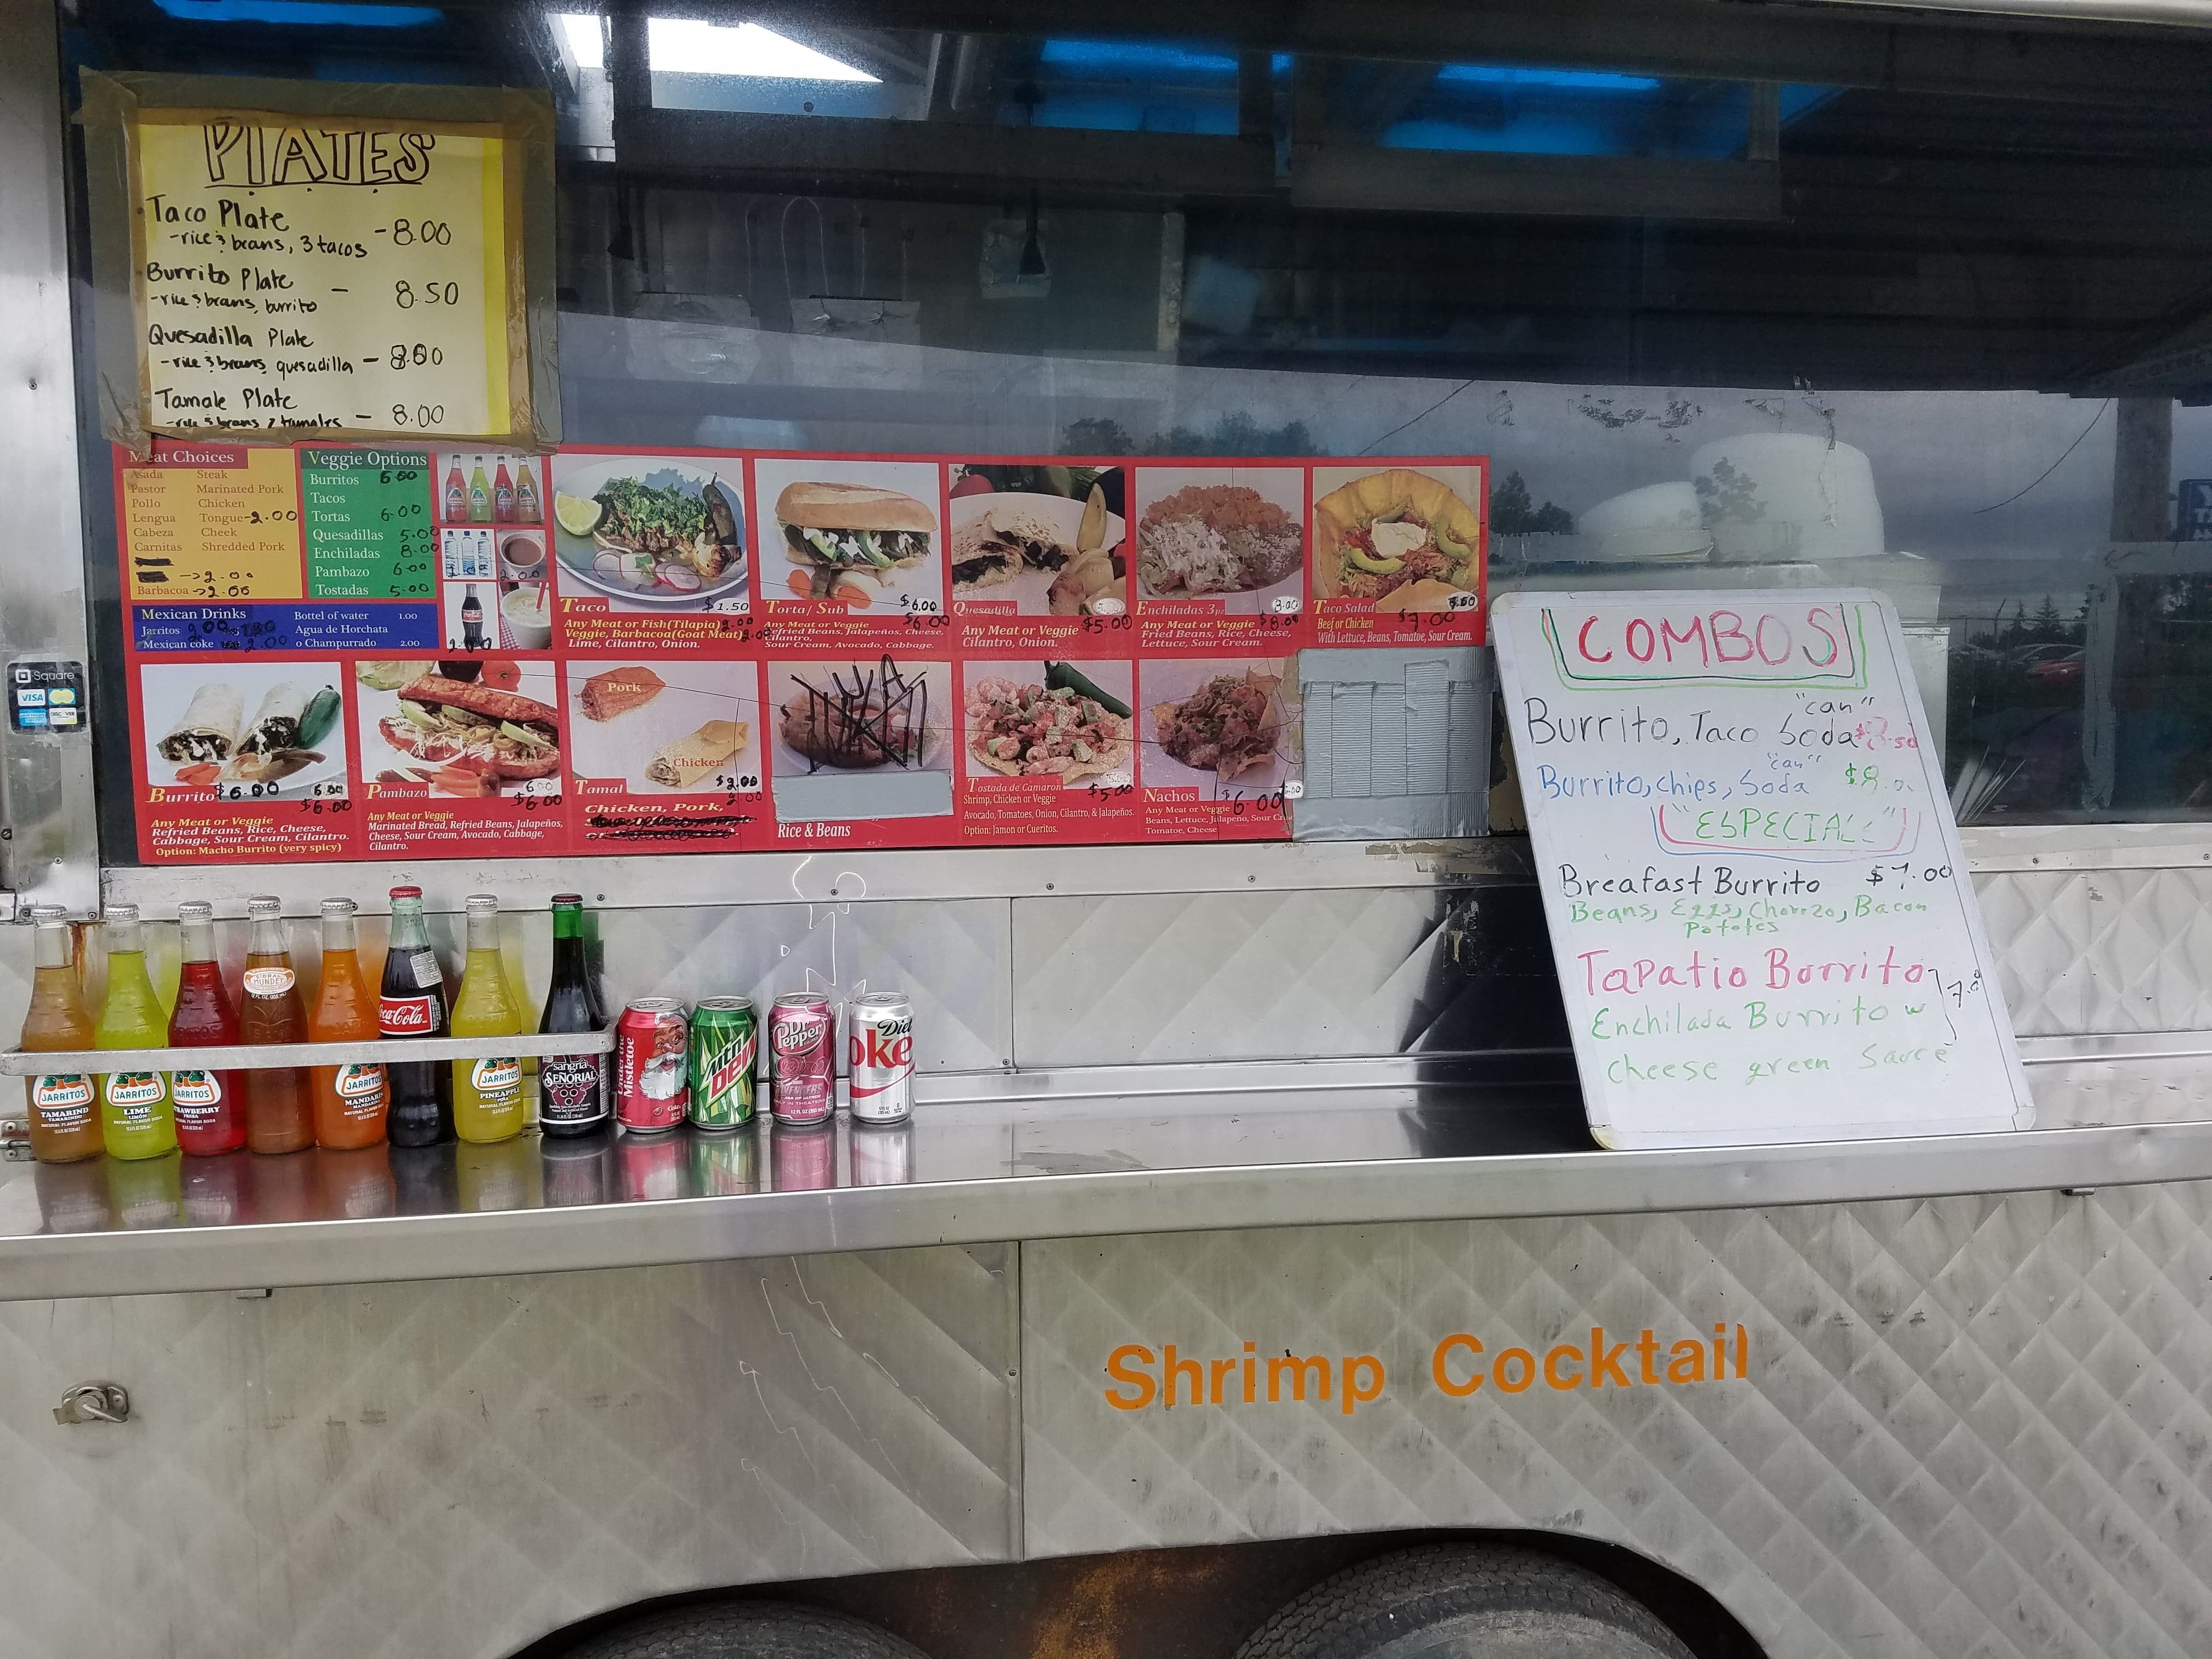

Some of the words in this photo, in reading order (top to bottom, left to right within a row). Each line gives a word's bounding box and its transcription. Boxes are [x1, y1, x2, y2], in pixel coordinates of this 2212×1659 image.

[145, 194, 206, 223] Taco
[218, 199, 290, 232] Plate
[300, 235, 313, 252] 3
[317, 234, 368, 258] tacos
[146, 261, 230, 285] Burrito
[241, 267, 294, 291] Plate
[395, 280, 460, 309] 8.50
[266, 298, 318, 313] burrito
[149, 324, 252, 347] Quesadilla
[269, 328, 314, 348] Plate
[276, 358, 354, 380] quesadilla
[154, 387, 227, 410] Tamale
[243, 388, 298, 409] Plate
[393, 404, 444, 427] 8.00
[173, 450, 234, 462] Choices
[309, 452, 363, 472] Veggie
[367, 452, 427, 473] Options
[197, 470, 228, 479] Steak
[310, 474, 359, 486] Burritos
[132, 485, 166, 493] Pastor
[196, 484, 253, 493] Marinated
[258, 485, 284, 493] Pork
[132, 499, 161, 507] Pollo
[199, 499, 245, 507] Chicken
[311, 493, 346, 503] Tacos
[133, 514, 176, 526] Lengua
[200, 513, 243, 526] Tongue
[312, 511, 350, 522] Tortas
[133, 527, 174, 537] Cabeza
[201, 527, 237, 537] Cheek
[313, 529, 383, 541] Quesadillas
[134, 542, 182, 551] Carnitas
[202, 541, 256, 551] Shredded
[259, 542, 285, 551] Pork
[314, 548, 380, 558] Enchiladas
[315, 566, 370, 577] Pambazo
[137, 586, 189, 595] Barbacoa
[316, 584, 369, 595] Tostadas
[560, 598, 606, 613] Taco
[816, 602, 844, 614] Sub
[953, 601, 1015, 617] Quesadilla
[1136, 601, 1203, 616] Enchiladas
[1313, 600, 1342, 614] Taco
[1345, 602, 1375, 612] Salad
[142, 609, 197, 619] Mexican
[202, 608, 246, 619] Drinks
[295, 611, 324, 620] Bottel
[328, 611, 338, 620] of
[341, 612, 369, 620] water
[296, 625, 323, 636] Agua
[326, 624, 338, 634] de
[341, 624, 388, 634] Horchata
[565, 619, 588, 629] Any
[642, 619, 720, 630] Fish(Tilapia)
[142, 627, 180, 636] Jarritos
[566, 629, 608, 640] Veggie,
[612, 630, 706, 639] Barbacoa(Goat
[708, 630, 743, 639] Meat)
[1578, 608, 1838, 667] COMBOS
[190, 640, 213, 648] coke
[305, 638, 376, 650] Champurrado
[34, 671, 75, 682] Square
[608, 682, 642, 692] Pork
[1525, 697, 1681, 747] Burrito,
[1690, 710, 1758, 744] Taco
[1780, 713, 1859, 748] Soda
[674, 758, 724, 767] Chicken
[575, 780, 623, 795] Tamal
[968, 778, 1007, 793] Tostada
[147, 788, 215, 803] Burrito
[366, 785, 427, 800] Pambazo
[1143, 789, 1195, 803] Nachos
[963, 795, 991, 806] Shrimp,
[994, 794, 1021, 804] Chicken
[1032, 793, 1056, 805] Veggie
[585, 805, 667, 813] Chicken,
[674, 803, 723, 812] Pork,
[964, 810, 996, 820] Avocado,
[997, 810, 1034, 819] Tomatoes,
[1035, 809, 1058, 818] Onion,
[1060, 808, 1090, 818] Cilantro,
[1092, 808, 1097, 816] &
[1099, 807, 1134, 817] Jalapeños.
[152, 827, 200, 837] Refried
[202, 826, 243, 836] Beans,
[247, 826, 276, 835] Rice,
[280, 825, 326, 834] Cheese,
[778, 823, 802, 838] Rice
[805, 823, 813, 837] &
[816, 823, 850, 837] Beans
[153, 836, 210, 846] Cabbage,
[295, 833, 349, 842] Cilantro.
[156, 848, 196, 856] Option:
[199, 846, 234, 854] Macho
[238, 845, 276, 854] Burrito
[279, 844, 308, 854] (very
[310, 843, 341, 853] spicy)
[1714, 866, 1821, 895] Burrito
[1571, 900, 1658, 923] Beans,
[1855, 895, 1927, 917] Bacon
[379, 1004, 424, 1025] Coca-Cola
[1592, 1001, 1732, 1040] Enchilada
[1747, 996, 1888, 1029] Burrito
[789, 1020, 810, 1034] Dr
[877, 1018, 912, 1036] Diet
[776, 1023, 822, 1049] Pepper
[554, 1059, 587, 1073] sangría
[624, 1037, 634, 1097] Mistletoe
[346, 1075, 381, 1089] JARRITOS
[482, 1070, 517, 1083] JARRITOS
[544, 1071, 596, 1087] SEÑORIAL
[42, 1090, 85, 1102] JARRITOS
[115, 1088, 157, 1099] JARRITOS
[345, 1092, 383, 1105] MANDARIN
[480, 1087, 520, 1098] PINEAPPLE
[41, 1107, 89, 1118] TAMARIND
[123, 1107, 152, 1115] LIME
[1103, 1340, 1386, 1414] Shrimp
[1432, 1322, 1748, 1398] Cocktail
